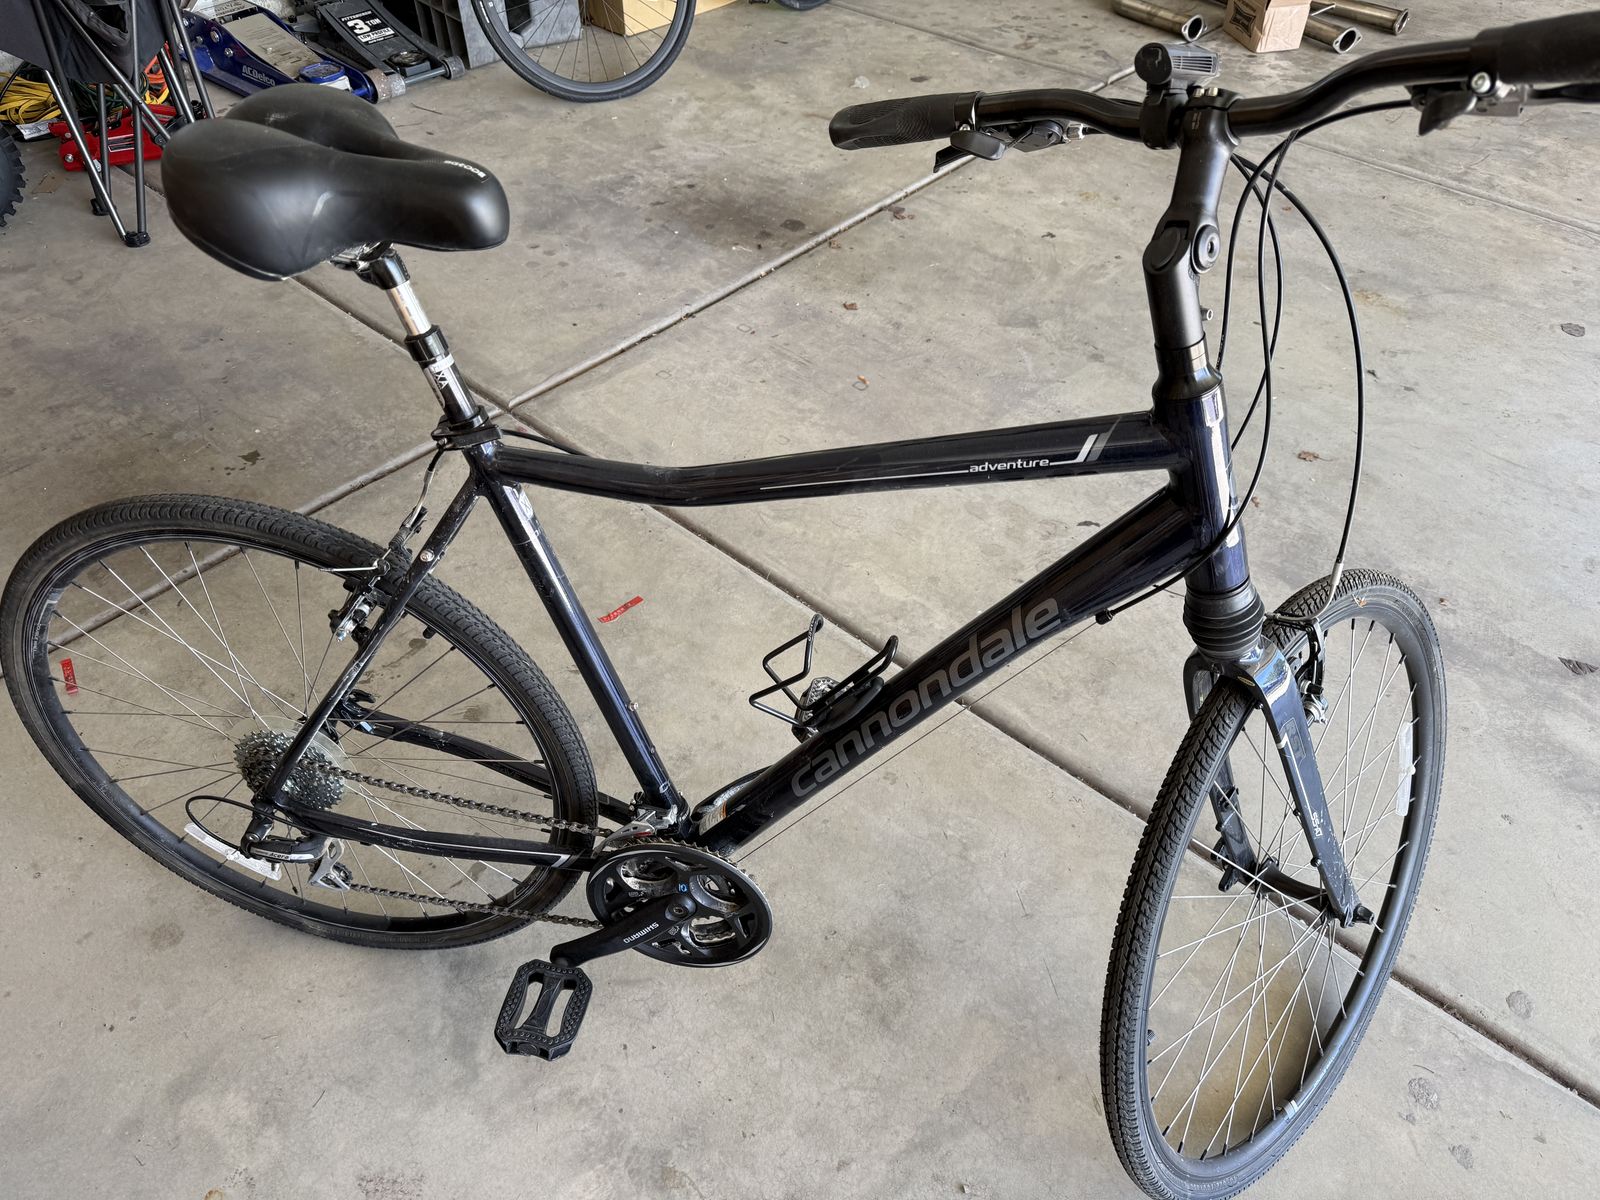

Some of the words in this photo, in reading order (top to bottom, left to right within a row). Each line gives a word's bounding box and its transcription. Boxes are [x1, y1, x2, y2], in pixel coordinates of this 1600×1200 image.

[346, 19, 371, 35] 3
[365, 18, 381, 26] TON
[242, 65, 276, 87] ACDelco
[969, 459, 1050, 473] adventure
[791, 597, 1062, 798] cannondale
[269, 852, 290, 860] Acera
[622, 921, 660, 944] SHIMANO
